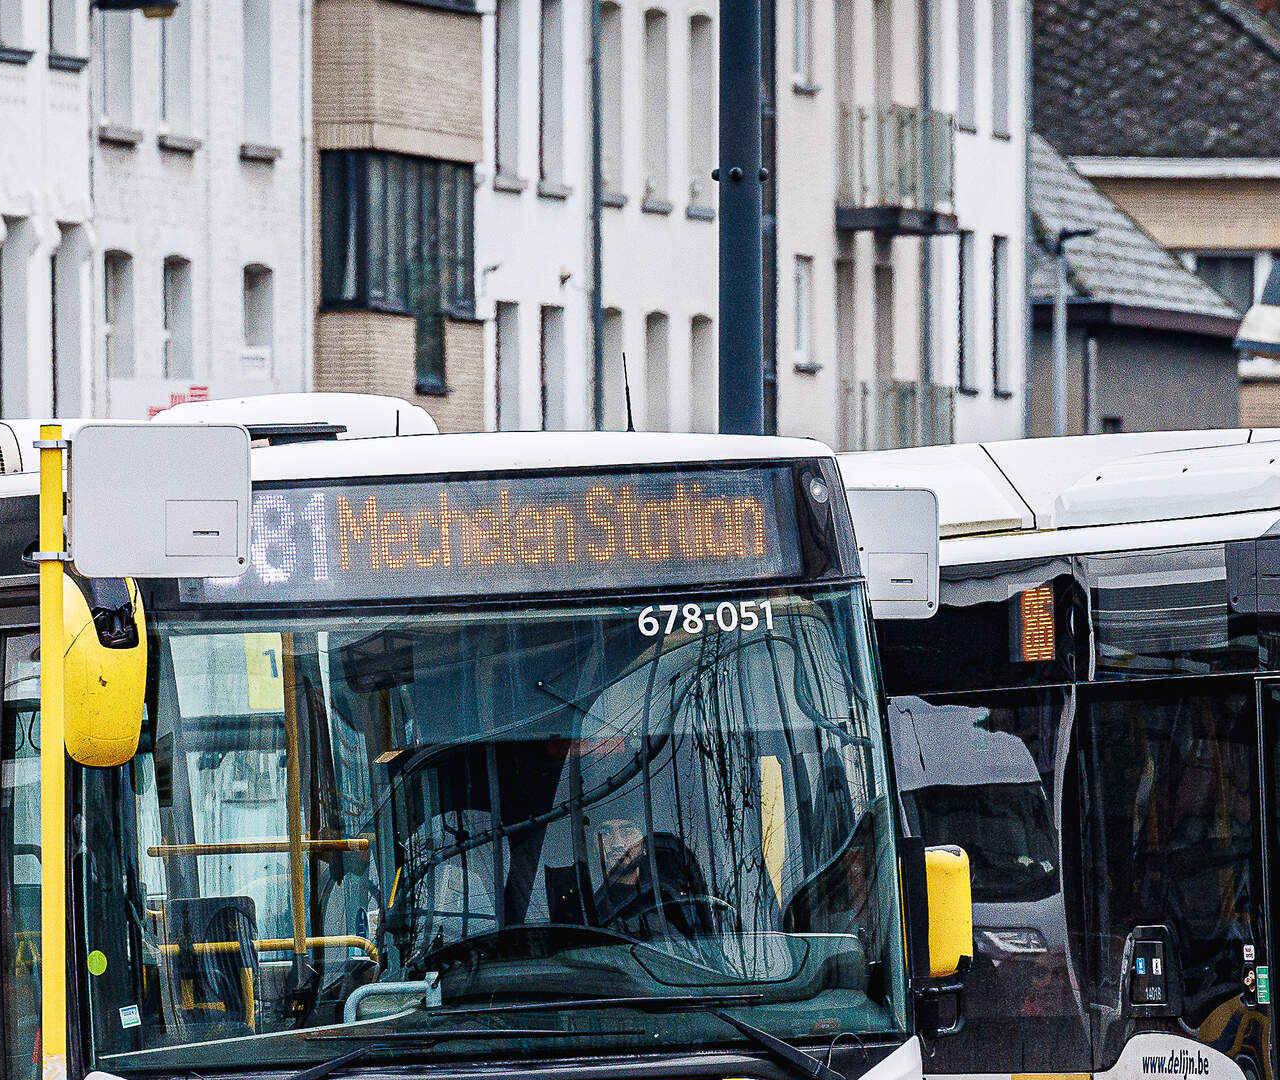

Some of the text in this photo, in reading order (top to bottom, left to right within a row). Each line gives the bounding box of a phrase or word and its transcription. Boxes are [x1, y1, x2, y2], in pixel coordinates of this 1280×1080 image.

[220, 483, 765, 583] 81 Mechelen Station
[638, 601, 774, 637] 678-051
[1142, 1049, 1210, 1080] www.delijn.be
